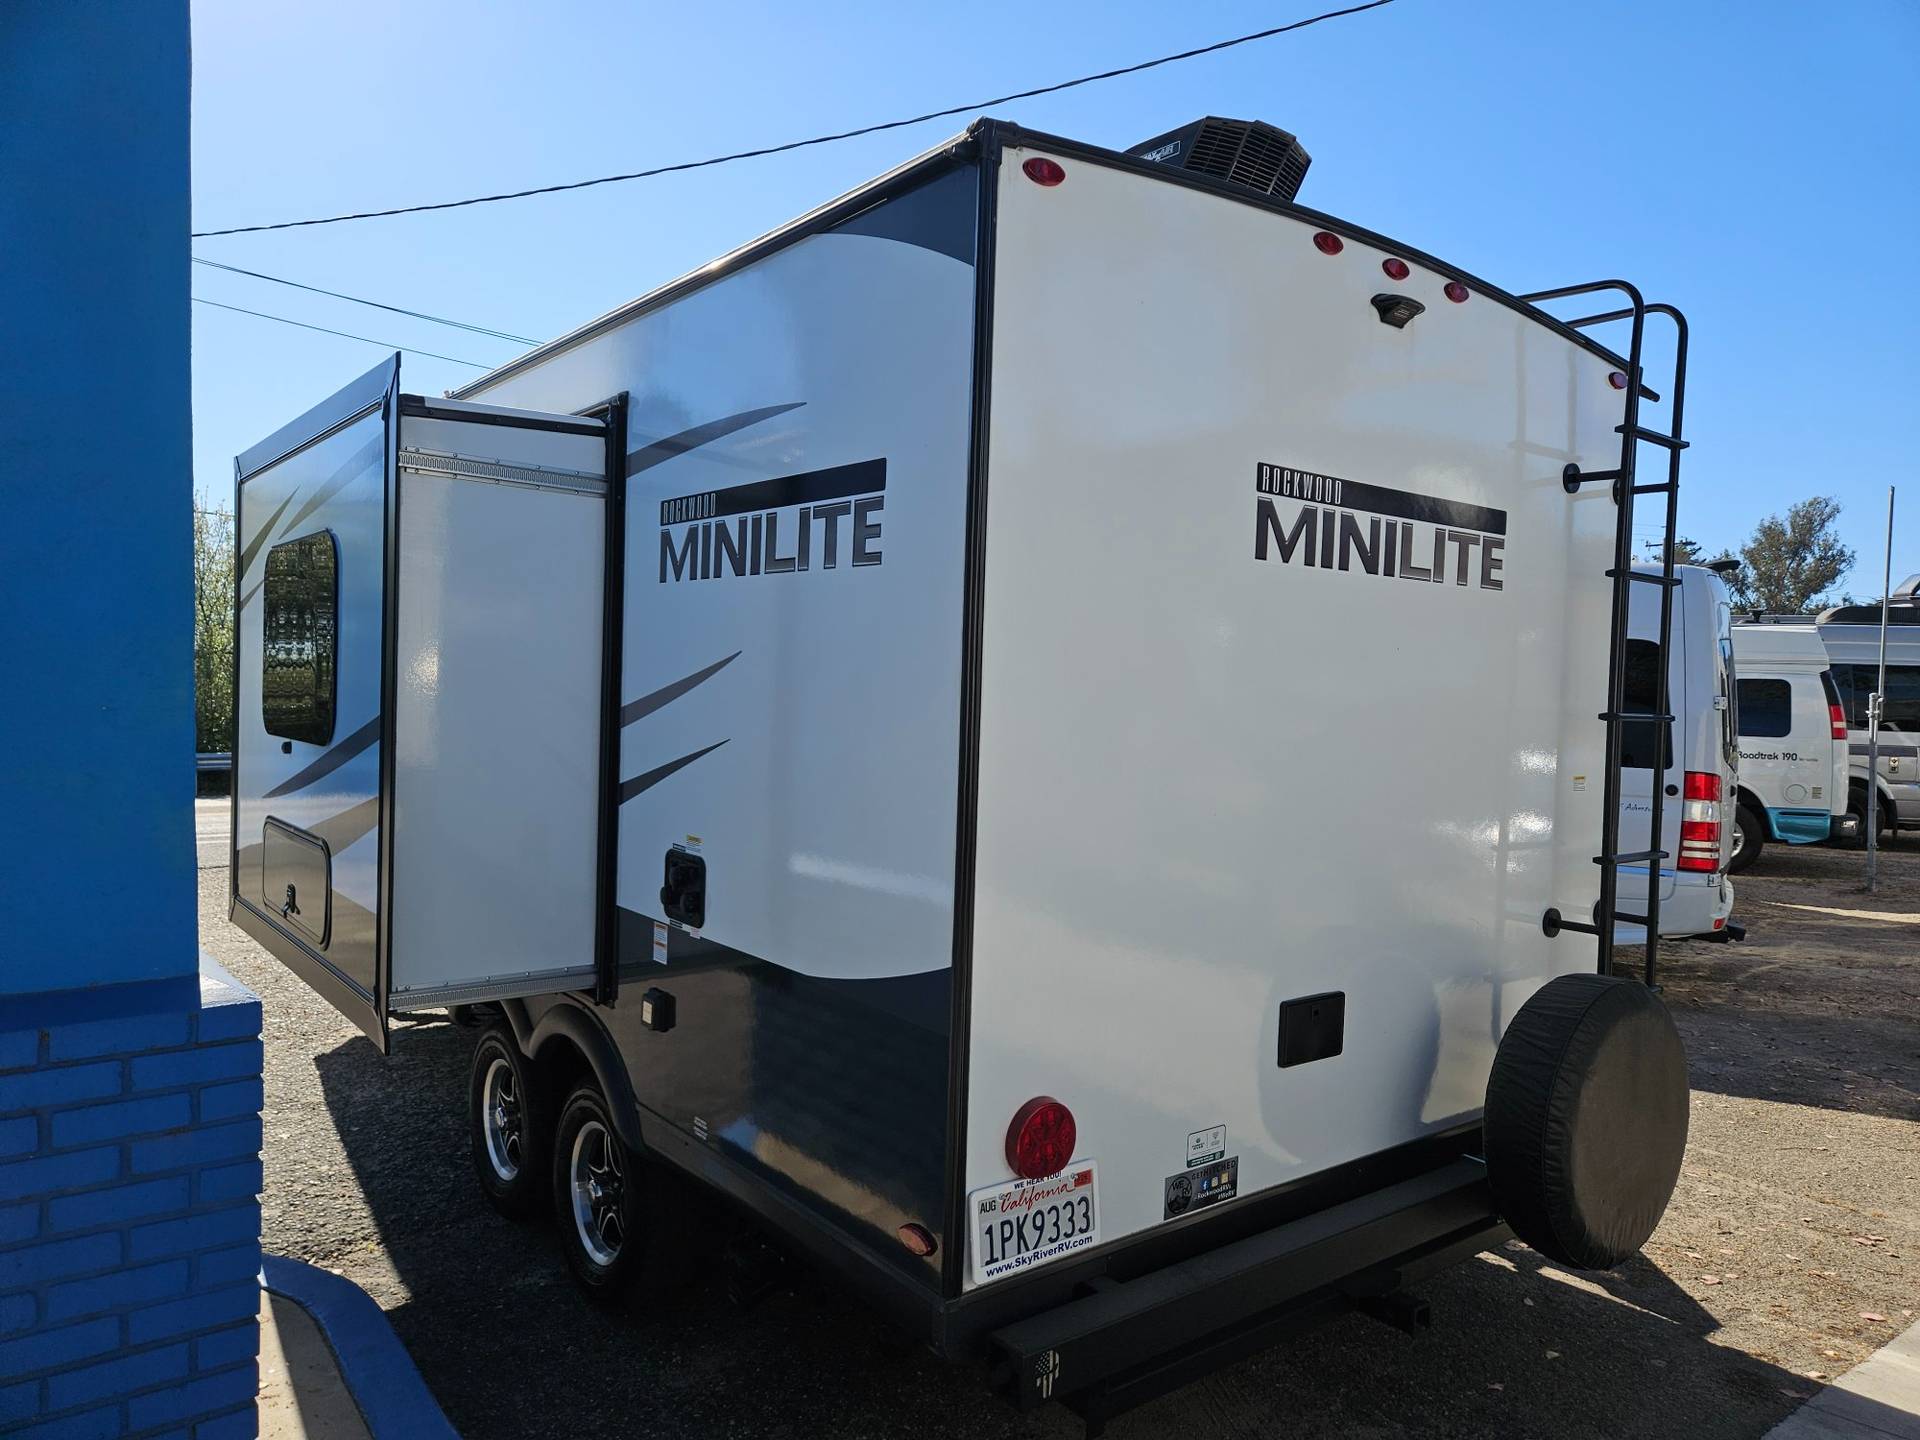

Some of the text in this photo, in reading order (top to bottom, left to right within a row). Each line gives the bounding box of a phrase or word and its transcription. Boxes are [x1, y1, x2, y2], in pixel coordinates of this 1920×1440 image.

[1261, 464, 1343, 506] ROCKWOOD
[662, 492, 717, 525] ROCKWOOD
[659, 495, 885, 584] MINILITE
[1254, 495, 1506, 591] MINILITE
[1782, 752, 1798, 762] 190
[1001, 1179, 1075, 1215] California
[1014, 1180, 1025, 1190] WE
[979, 1199, 997, 1215] AUG
[984, 1196, 1091, 1266] 1PK9333
[986, 1235, 1093, 1278] www.SkyRiverRV.com
